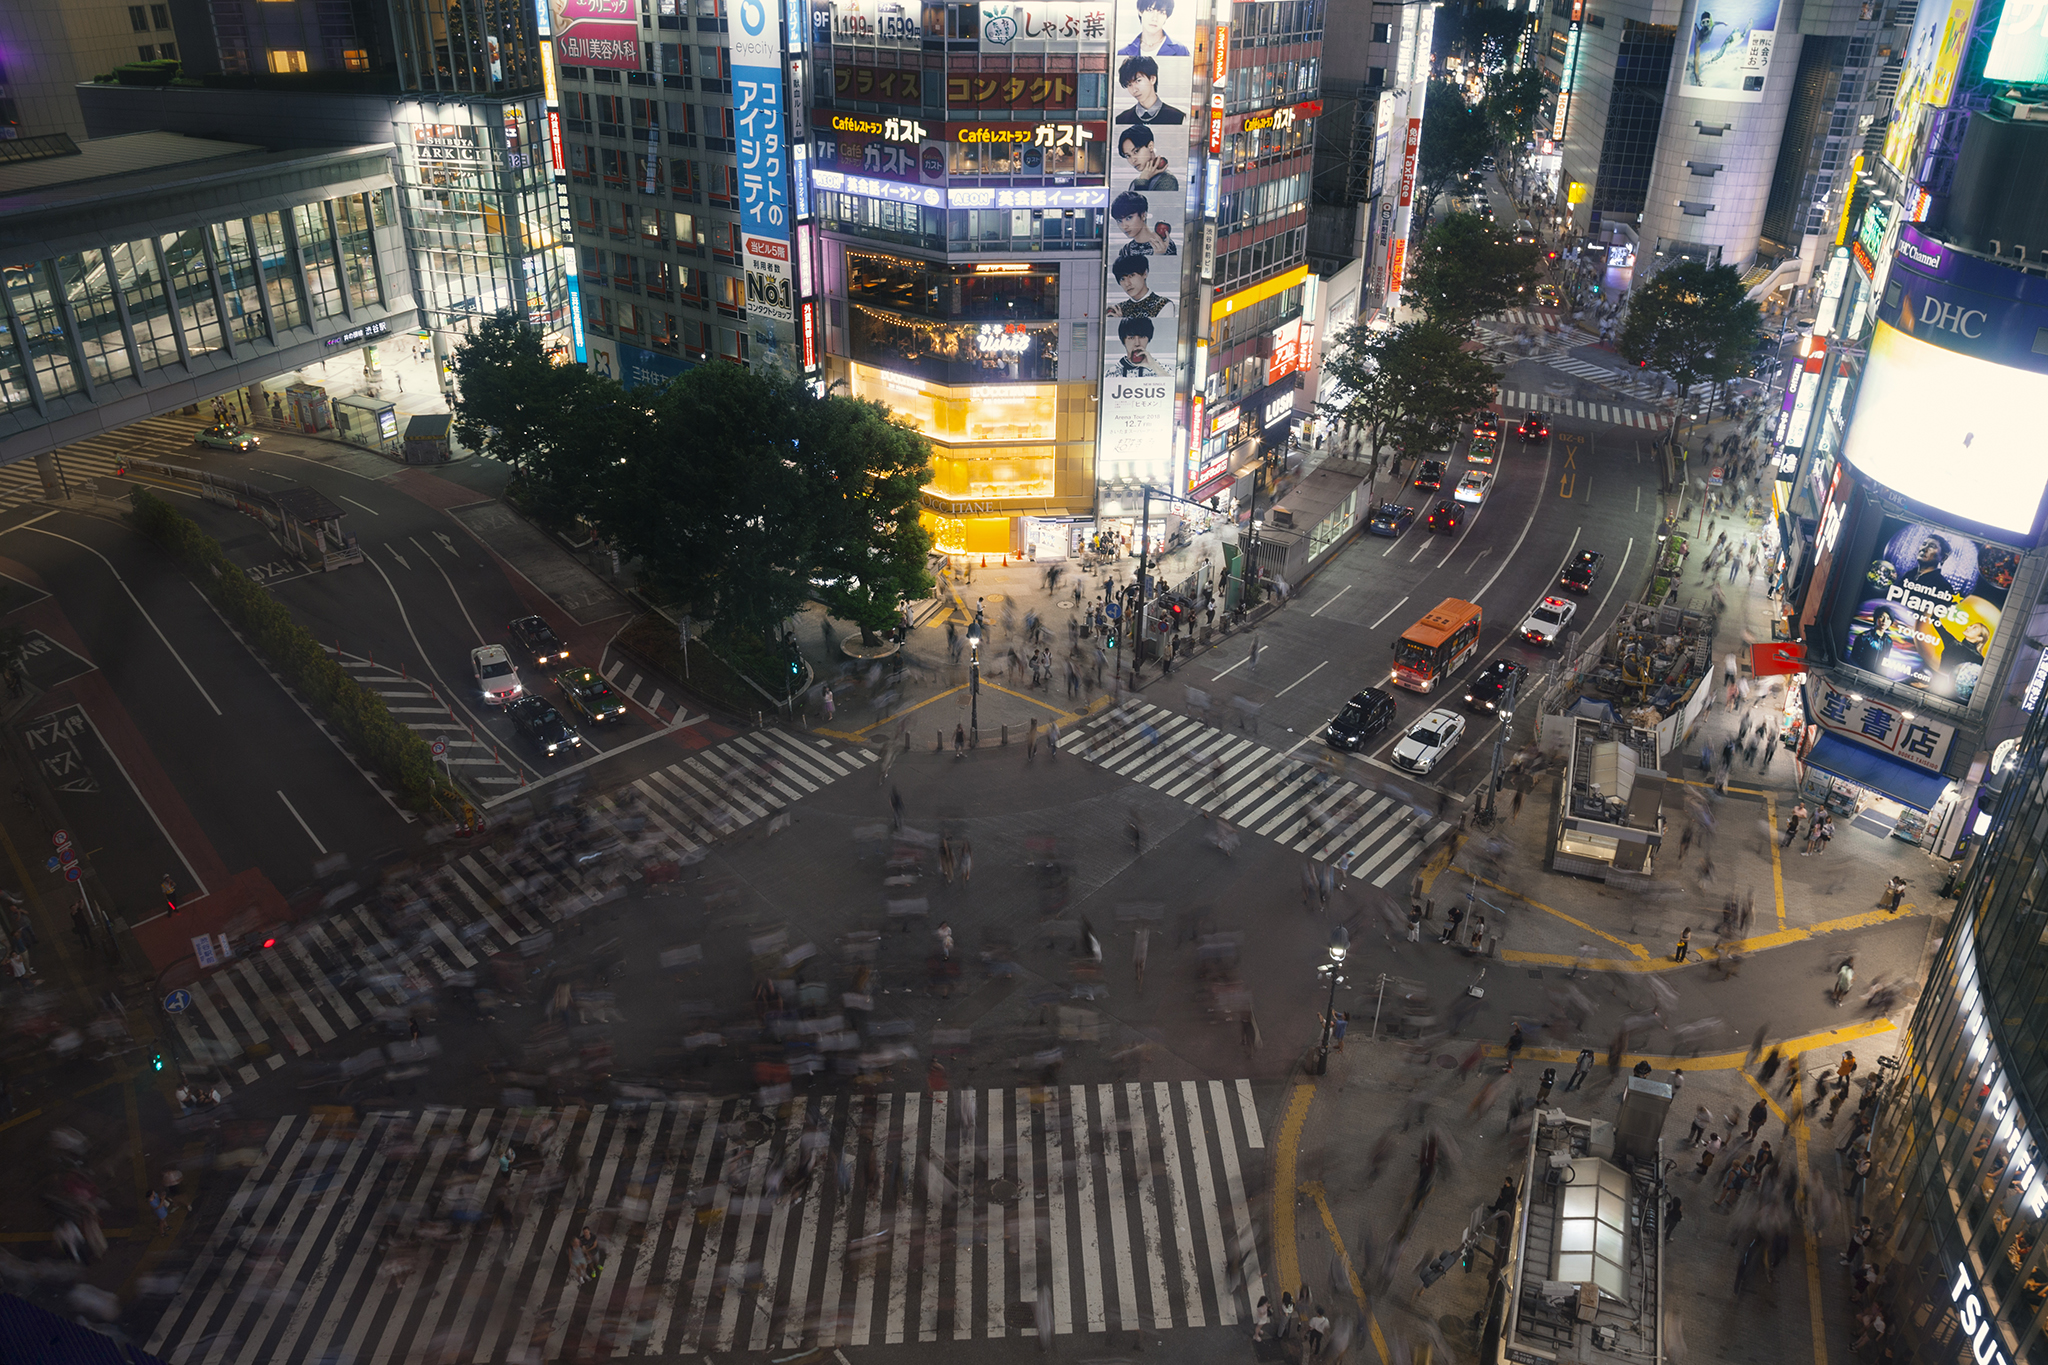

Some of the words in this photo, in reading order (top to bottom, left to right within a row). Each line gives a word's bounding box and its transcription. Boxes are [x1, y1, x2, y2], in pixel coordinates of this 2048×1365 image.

[789, 0, 798, 40] リバブル
[813, 11, 829, 28] 9F
[1025, 11, 1105, 39] しゃぶ葉
[568, 38, 637, 62] 品川美容外科
[736, 41, 773, 58] eyecity
[1748, 57, 1768, 66] おう
[1750, 47, 1770, 57] 出会
[835, 69, 919, 98] プライス
[948, 77, 1074, 103] コンタクト
[793, 79, 803, 128] 献血ルーム
[1272, 107, 1296, 131] ガスト
[1554, 97, 1567, 137] HOOTERS
[427, 136, 474, 147] SHIBUYA
[832, 116, 882, 134] Caféレストラン
[884, 117, 927, 144] ガスト
[958, 129, 1031, 143] Caféレストラン
[1034, 124, 1093, 147] ガスト
[1212, 120, 1222, 148] ガスト
[1408, 127, 1418, 146] 免税
[738, 81, 765, 223] アイシティ
[762, 83, 783, 227] コンタクトの
[817, 141, 836, 158] 7F
[840, 143, 862, 158] Café
[863, 143, 915, 176] ガスト
[1025, 155, 1041, 163] ガスト
[925, 160, 943, 171] ガスト
[1401, 153, 1416, 198] TaxFree
[847, 176, 922, 202] 英会話イーオン
[953, 191, 990, 206] AEON
[998, 189, 1105, 207] 英会話イーオン
[750, 241, 786, 259] 当ビル5階
[1203, 227, 1213, 274] 渋谷駅前ビル
[1909, 244, 1942, 269] Channel
[752, 259, 781, 274] 利用者数
[748, 302, 792, 320] コンタクトショップ
[1919, 295, 1988, 339] DHC
[343, 329, 364, 342] 井の頭線
[365, 321, 387, 336] 渋谷駅
[1111, 384, 1166, 400] Jesus
[1265, 390, 1294, 423] LUSH
[1125, 420, 1142, 428] 12.7
[1559, 433, 1585, 445] 8-20
[1903, 577, 1953, 602] teamLab
[1886, 584, 1970, 626] Planets
[1905, 610, 1943, 628] TOKYO
[1897, 624, 1941, 646] TOYOSU
[1881, 657, 1932, 683] DMM.com
[25, 714, 86, 751] バス停
[1897, 749, 1916, 762] BOOKS
[1915, 756, 1939, 770] TAISEIDO
[1950, 1260, 2010, 1365] TSU
